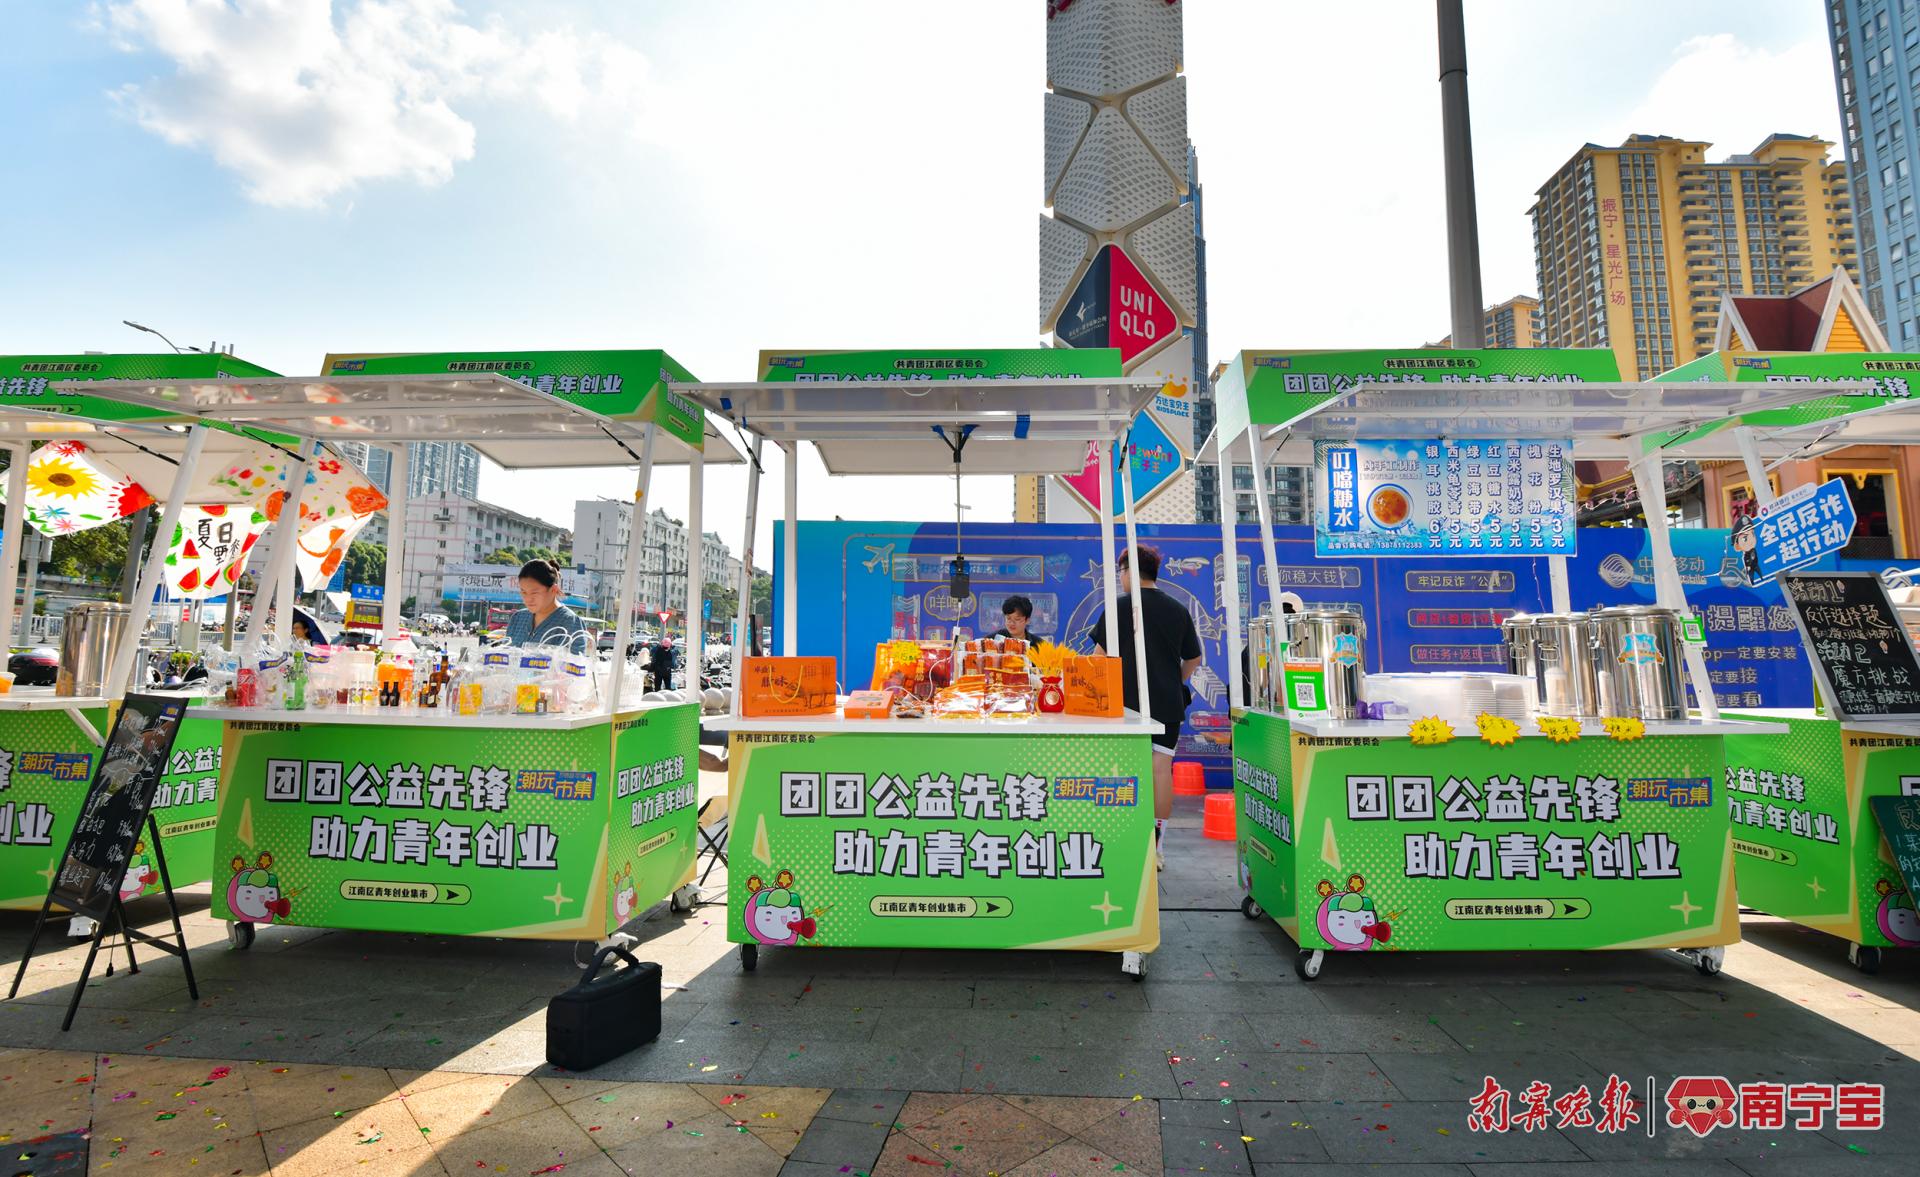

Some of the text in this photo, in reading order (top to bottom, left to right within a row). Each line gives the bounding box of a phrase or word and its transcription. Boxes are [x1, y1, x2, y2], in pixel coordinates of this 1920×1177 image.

[1602, 198, 1626, 306] 振宁·星光广场
[1120, 285, 1153, 316] UNI
[1120, 311, 1155, 340] QLO
[450, 361, 532, 370] 共青团江南区委员会
[896, 359, 985, 369] 共青团江南区委员会
[1386, 359, 1477, 368] 共青团江南区委员会
[1760, 494, 1844, 548] 全民反诈
[1763, 520, 1847, 564] 一起行动
[1639, 557, 1704, 572] 中移动
[230, 721, 301, 732] 共青团江南区委员会
[736, 733, 816, 744] 共青团江南区委员会
[1298, 736, 1380, 747] 共青团江南区委员会
[265, 758, 511, 813] 团团公益先锋
[617, 754, 685, 799] 团团公益先锋
[631, 782, 695, 829] 助力青年创业
[780, 771, 1050, 821] 团团公益先锋
[1346, 774, 1622, 823] 团团公益先锋
[308, 813, 560, 870] 助力青年创业
[833, 829, 1105, 880] 助力青年创业
[1403, 832, 1683, 881] 助力青年创业
[348, 886, 428, 900] 江南区青年创业集市
[879, 902, 967, 914] 江南区青年创业集市
[1454, 904, 1545, 917] 江南区青年创业集市
